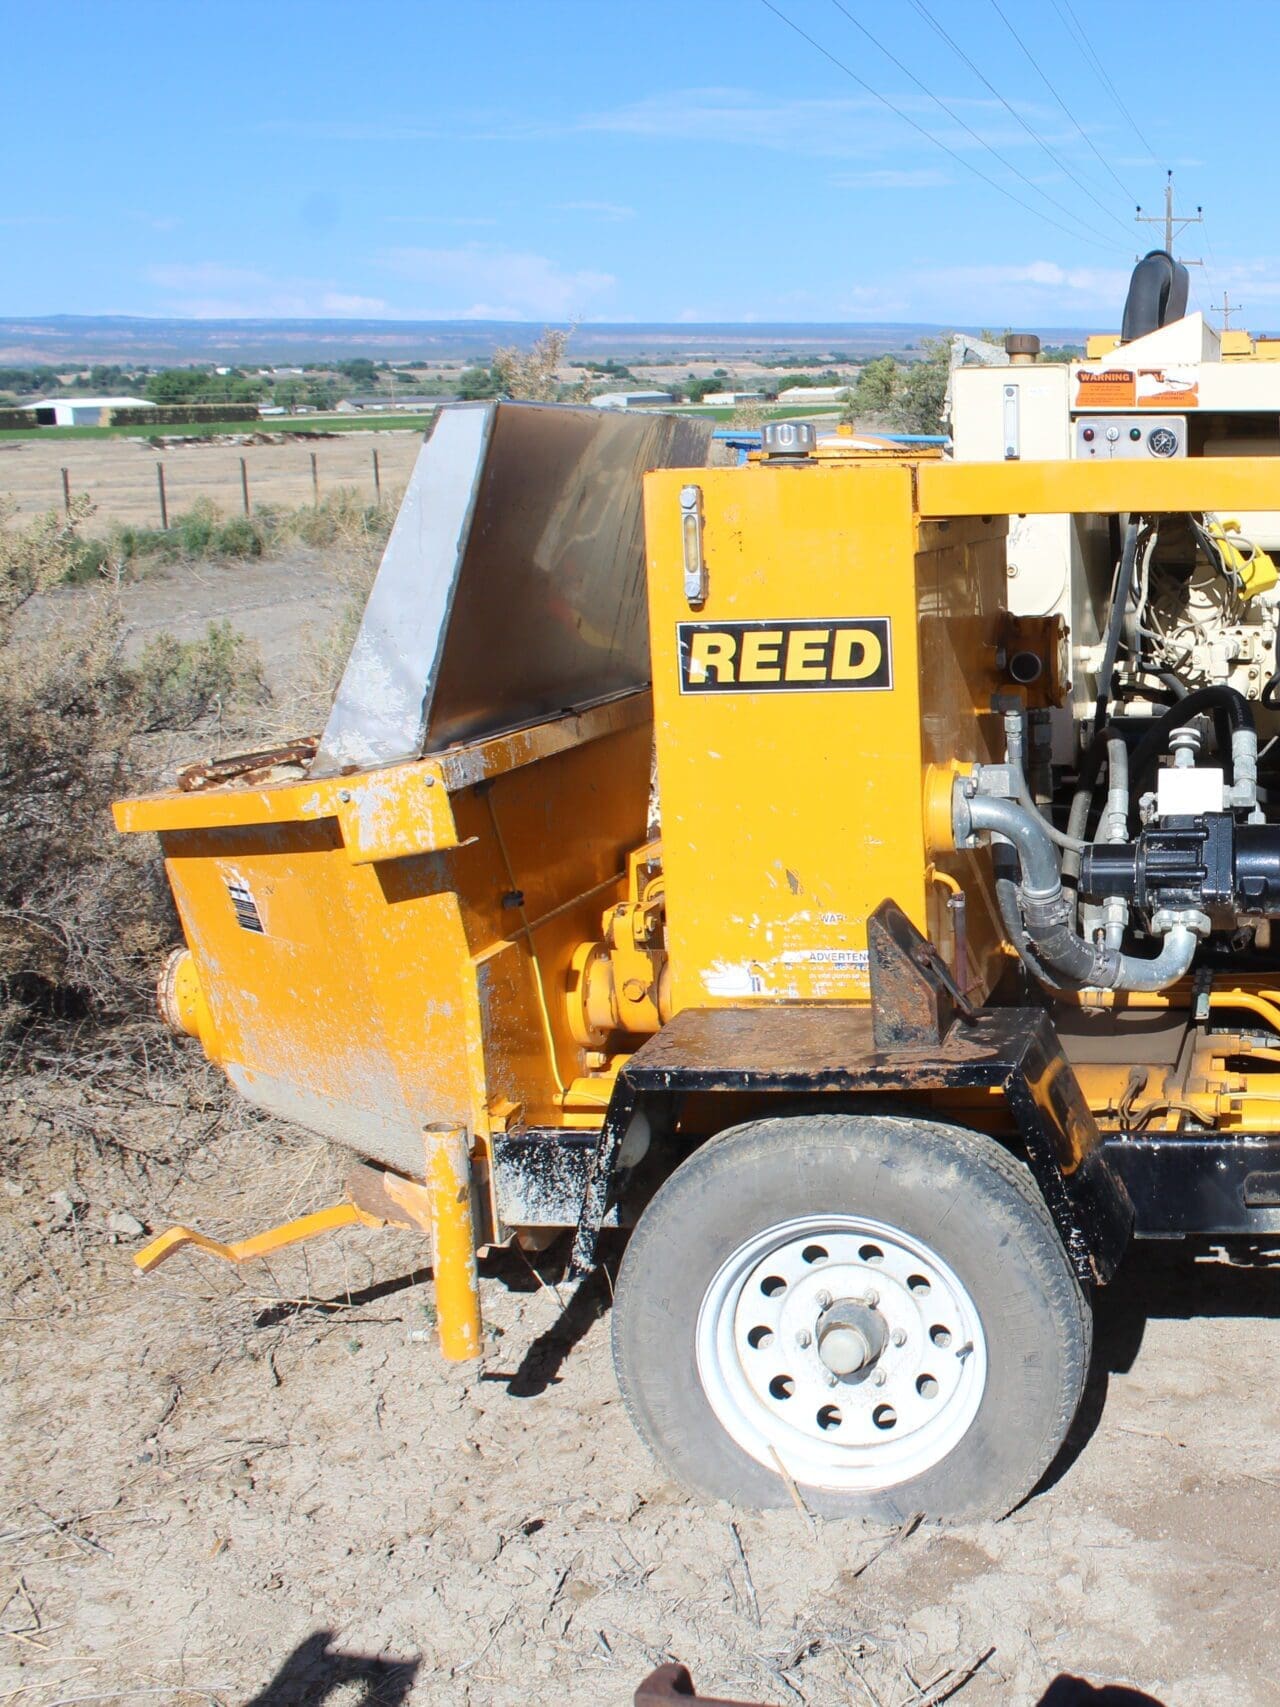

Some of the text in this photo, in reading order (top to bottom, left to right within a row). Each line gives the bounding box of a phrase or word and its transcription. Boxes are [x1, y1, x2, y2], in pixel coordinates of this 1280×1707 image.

[1080, 373, 1130, 382] WARNING
[688, 628, 882, 684] REED
[809, 951, 869, 962] ADVERTEN
